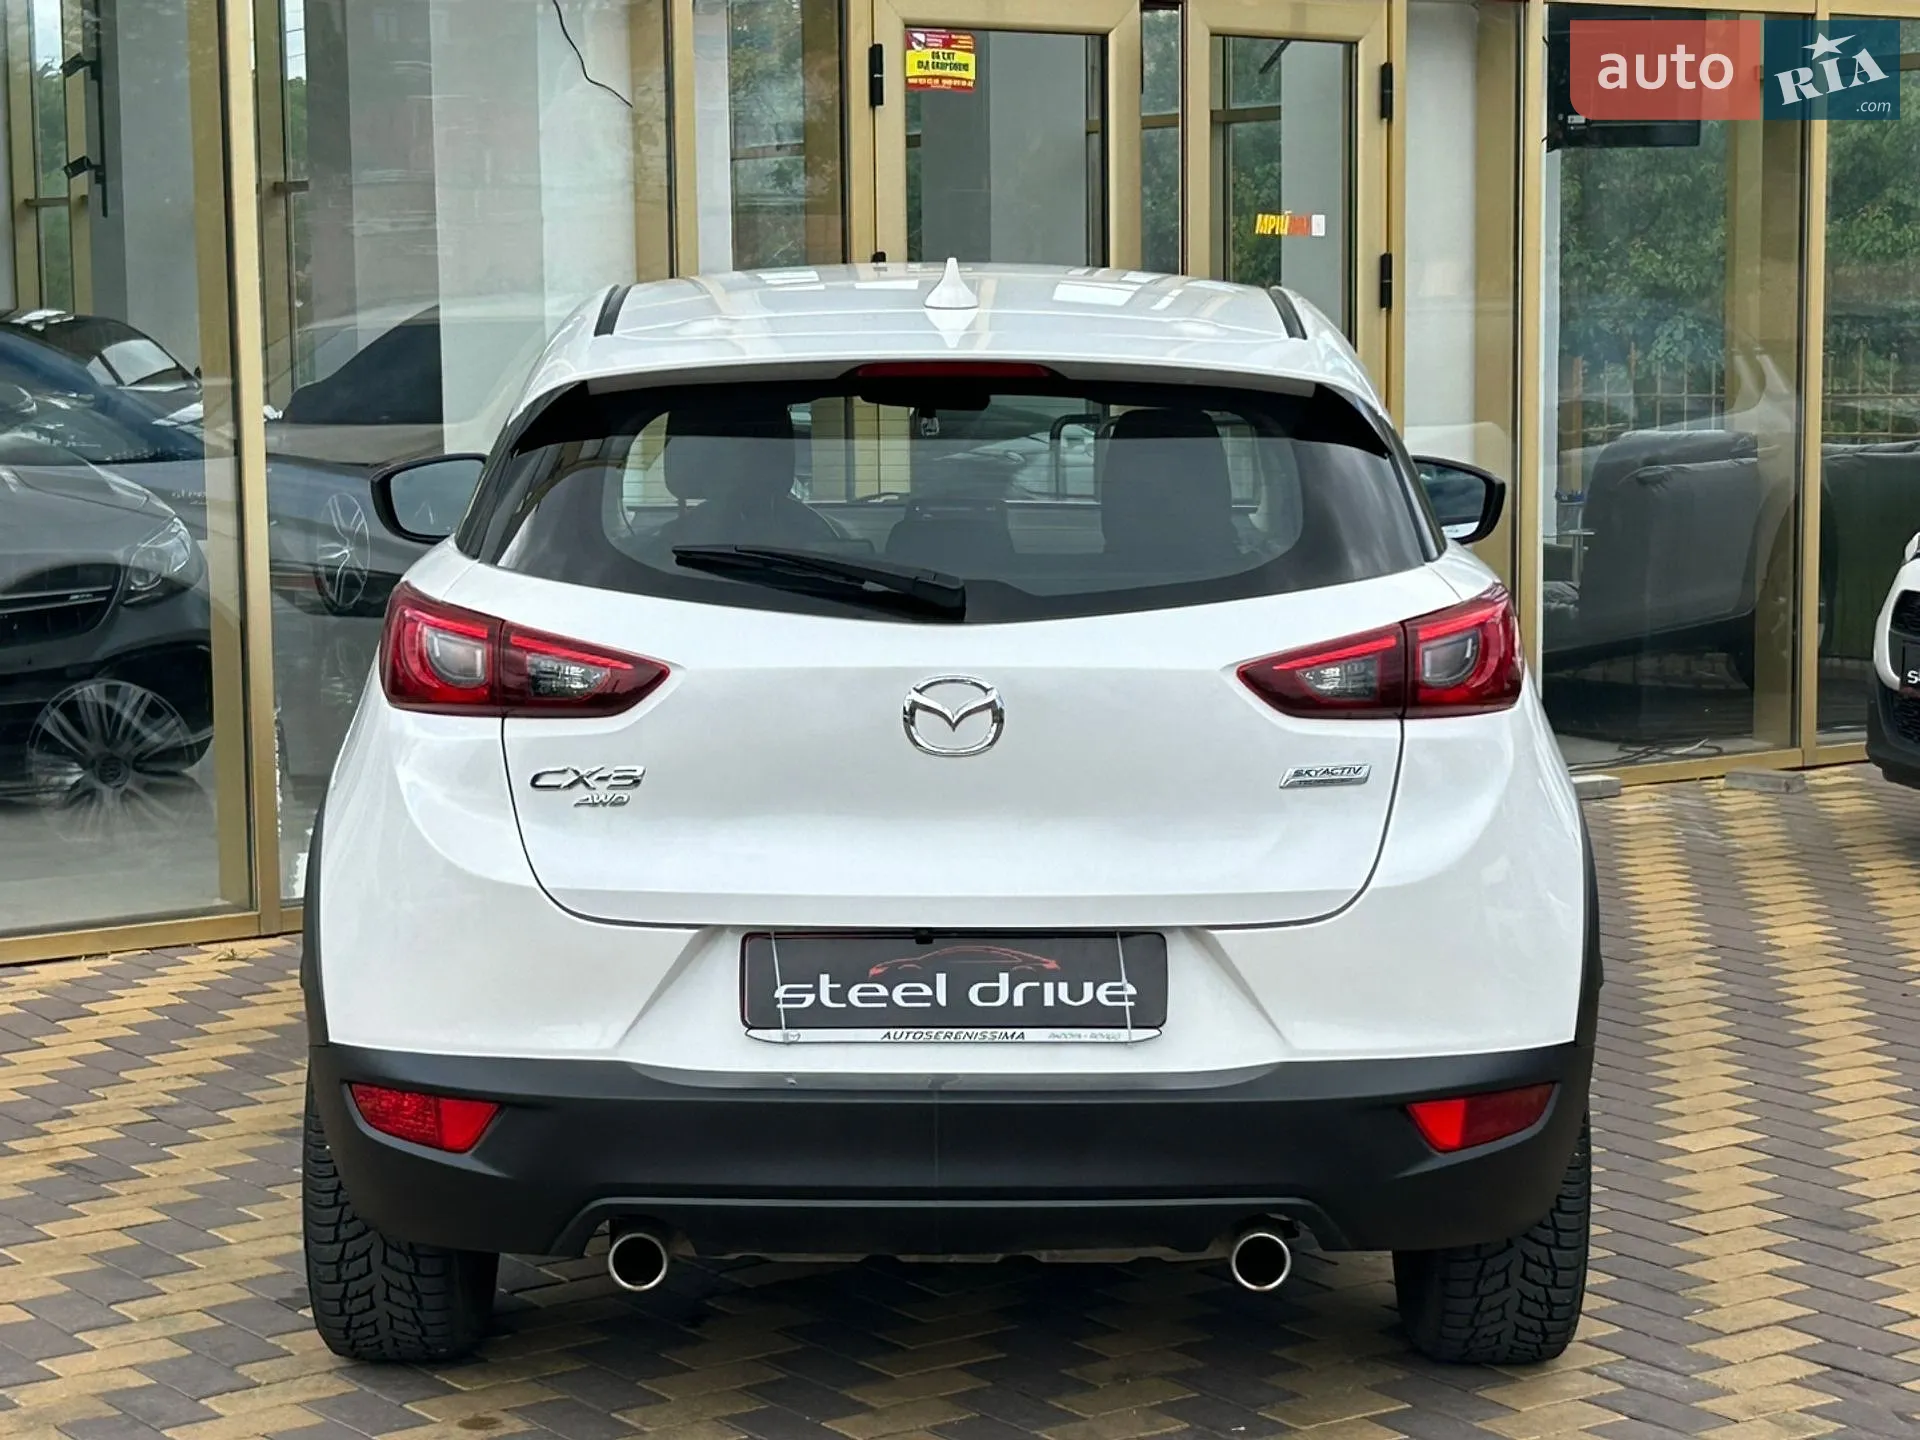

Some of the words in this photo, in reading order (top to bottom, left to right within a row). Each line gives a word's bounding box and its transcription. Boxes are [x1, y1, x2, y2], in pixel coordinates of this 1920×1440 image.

[529, 765, 646, 791] CX-3
[1292, 766, 1363, 778] SKYACTIV
[573, 792, 631, 808] AWD
[773, 972, 947, 1009] steel
[968, 972, 1138, 1007] drive
[880, 1030, 1026, 1042] AUTOSERENISSIMA
